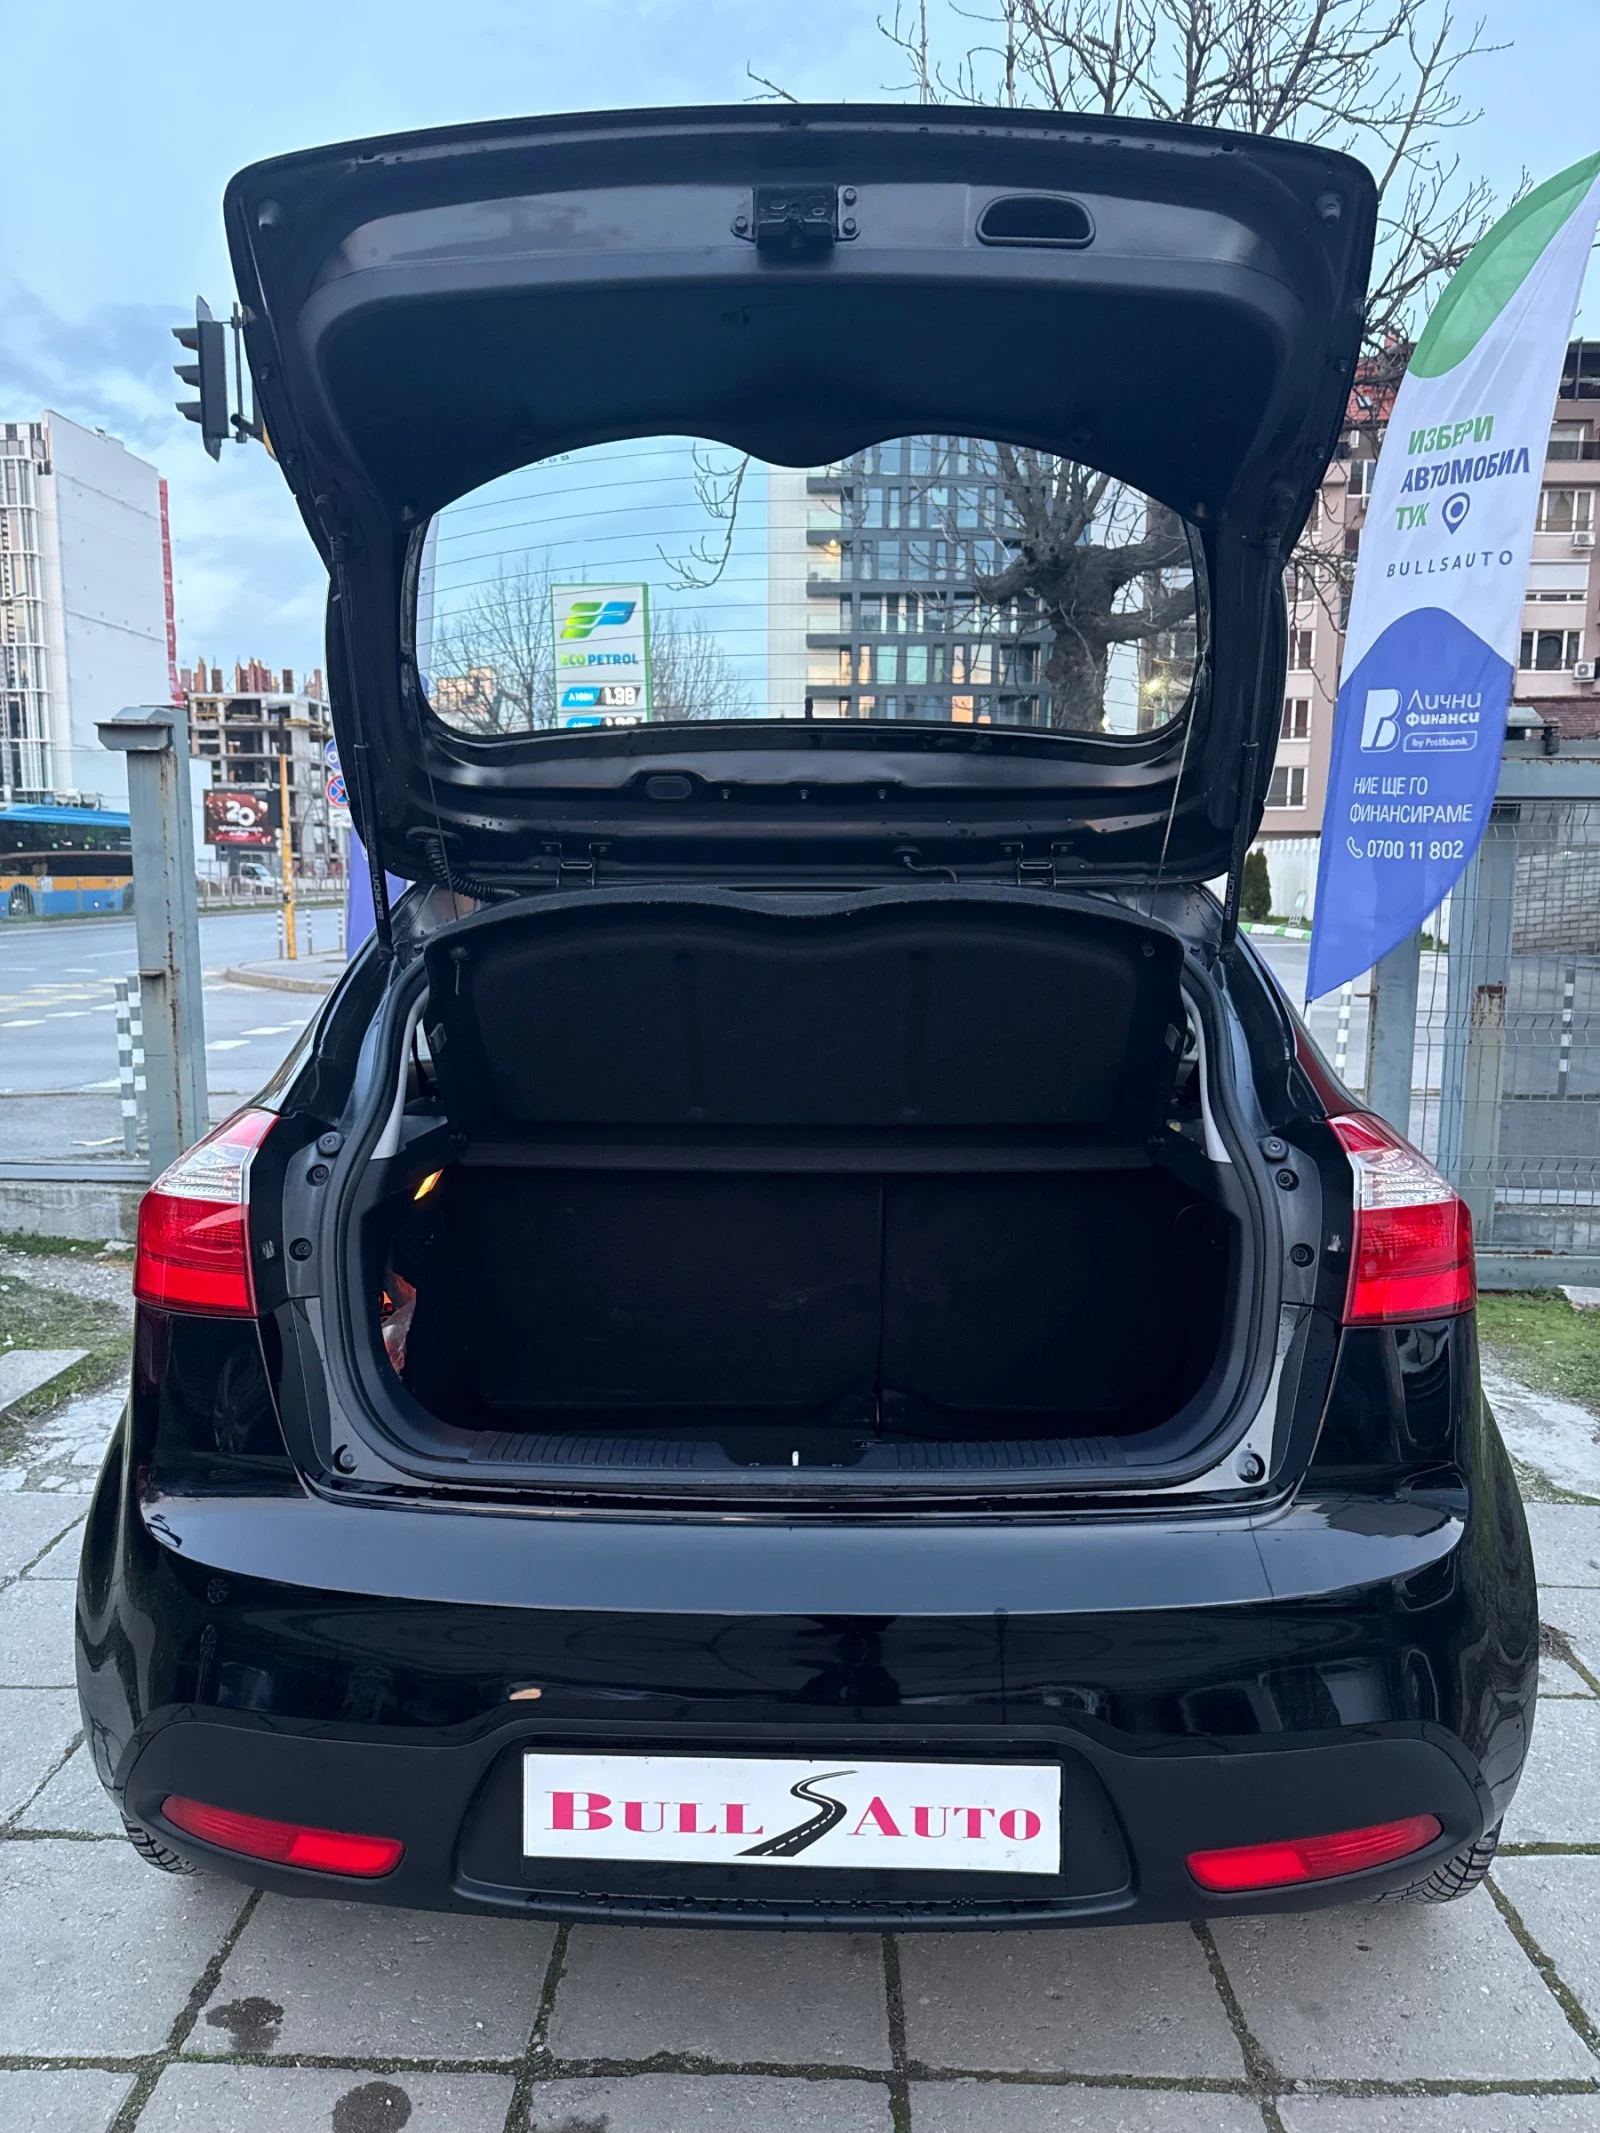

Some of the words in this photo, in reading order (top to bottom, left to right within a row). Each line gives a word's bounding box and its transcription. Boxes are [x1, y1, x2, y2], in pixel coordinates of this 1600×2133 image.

[1407, 415, 1494, 455] ИЗБЕРИ
[1400, 447, 1530, 493] АВТОМОБИЛ
[1395, 502, 1430, 531] ТУК
[1386, 550, 1513, 578] BULLSAUTO
[588, 653, 638, 665] PETROL
[1406, 689, 1482, 711] Лични
[1405, 712, 1480, 727] Финанси
[1411, 737, 1424, 748] by
[1425, 736, 1468, 747] Postbank
[1353, 777, 1378, 795] НИЕ
[1381, 777, 1405, 796] ЩЕ
[1409, 777, 1428, 795] ГО
[226, 800, 255, 826] 20
[1350, 803, 1473, 823] ФИНАНСИРАМЕ
[1367, 840, 1404, 859] 0700
[1409, 841, 1423, 860] 11
[1429, 840, 1464, 860] 802
[544, 1790, 764, 1836] BULL
[846, 1796, 1042, 1841] AUTO
